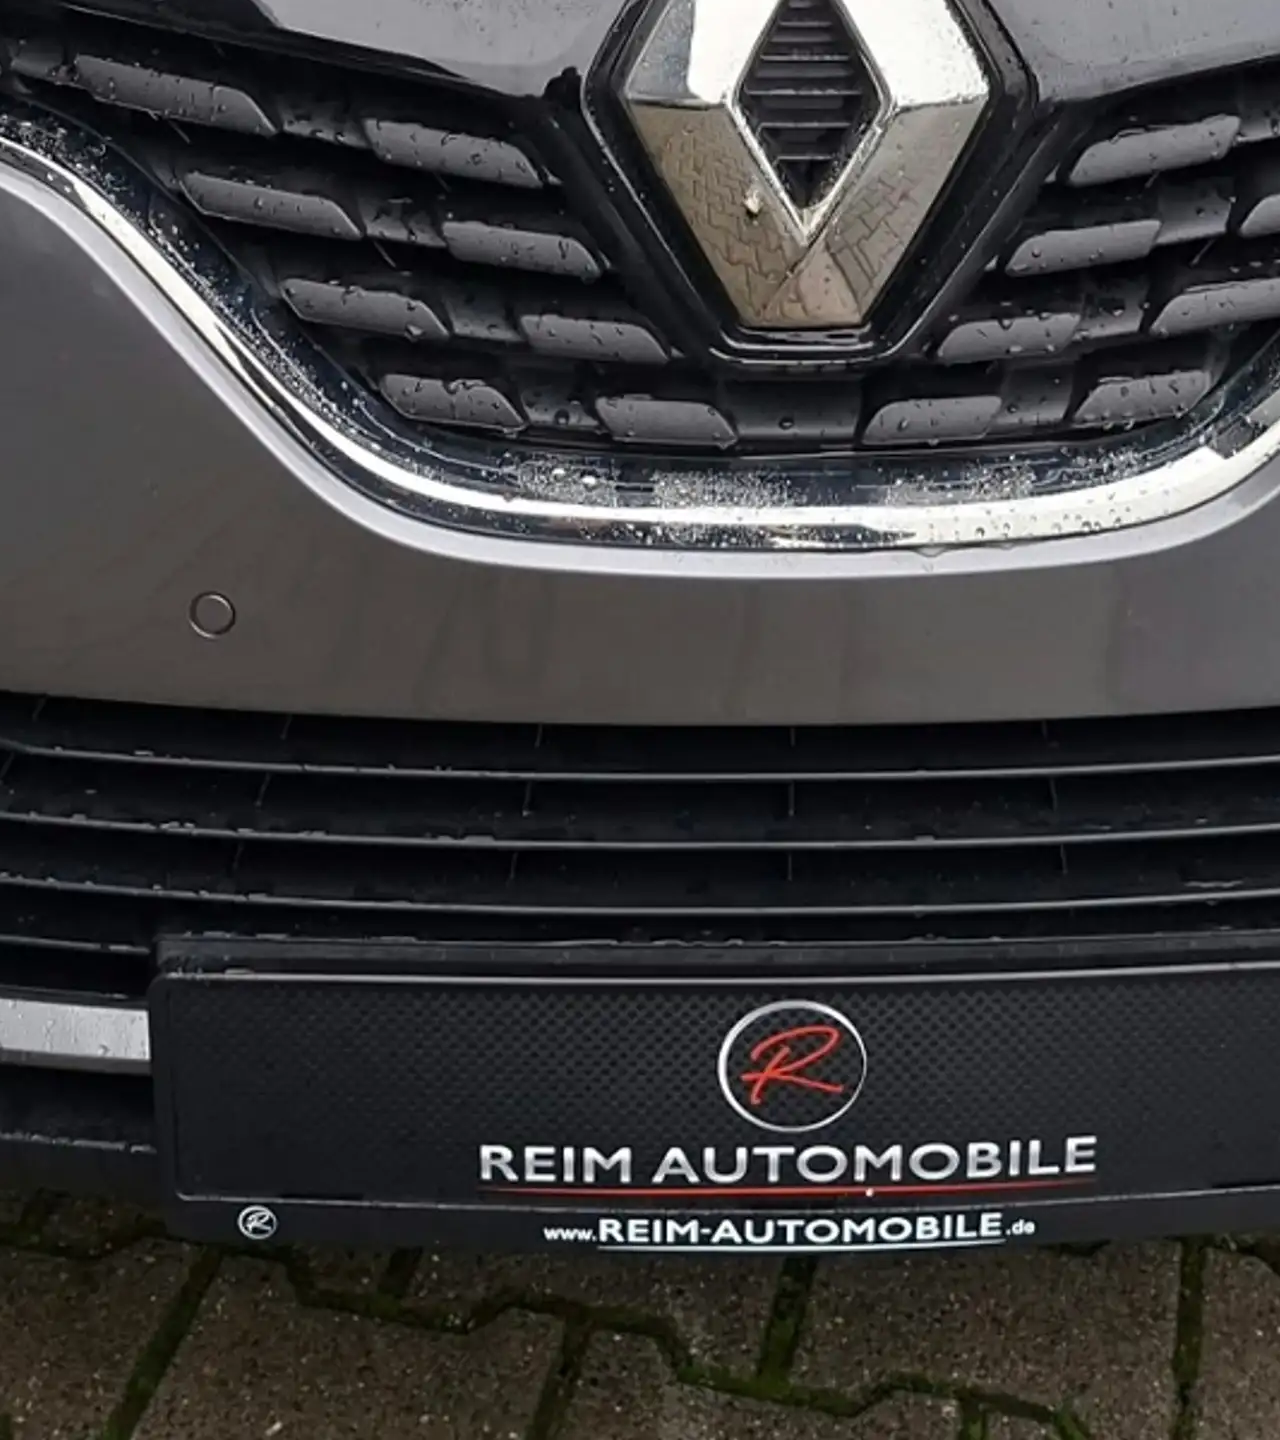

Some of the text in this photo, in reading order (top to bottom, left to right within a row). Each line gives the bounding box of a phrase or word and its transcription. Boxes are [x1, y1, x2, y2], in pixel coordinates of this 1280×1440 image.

[740, 1024, 845, 1105] R
[478, 1135, 1098, 1185] REIM AUTOMOBILE
[542, 1212, 1036, 1245] www.REIM-AUTOMOBILE.de
